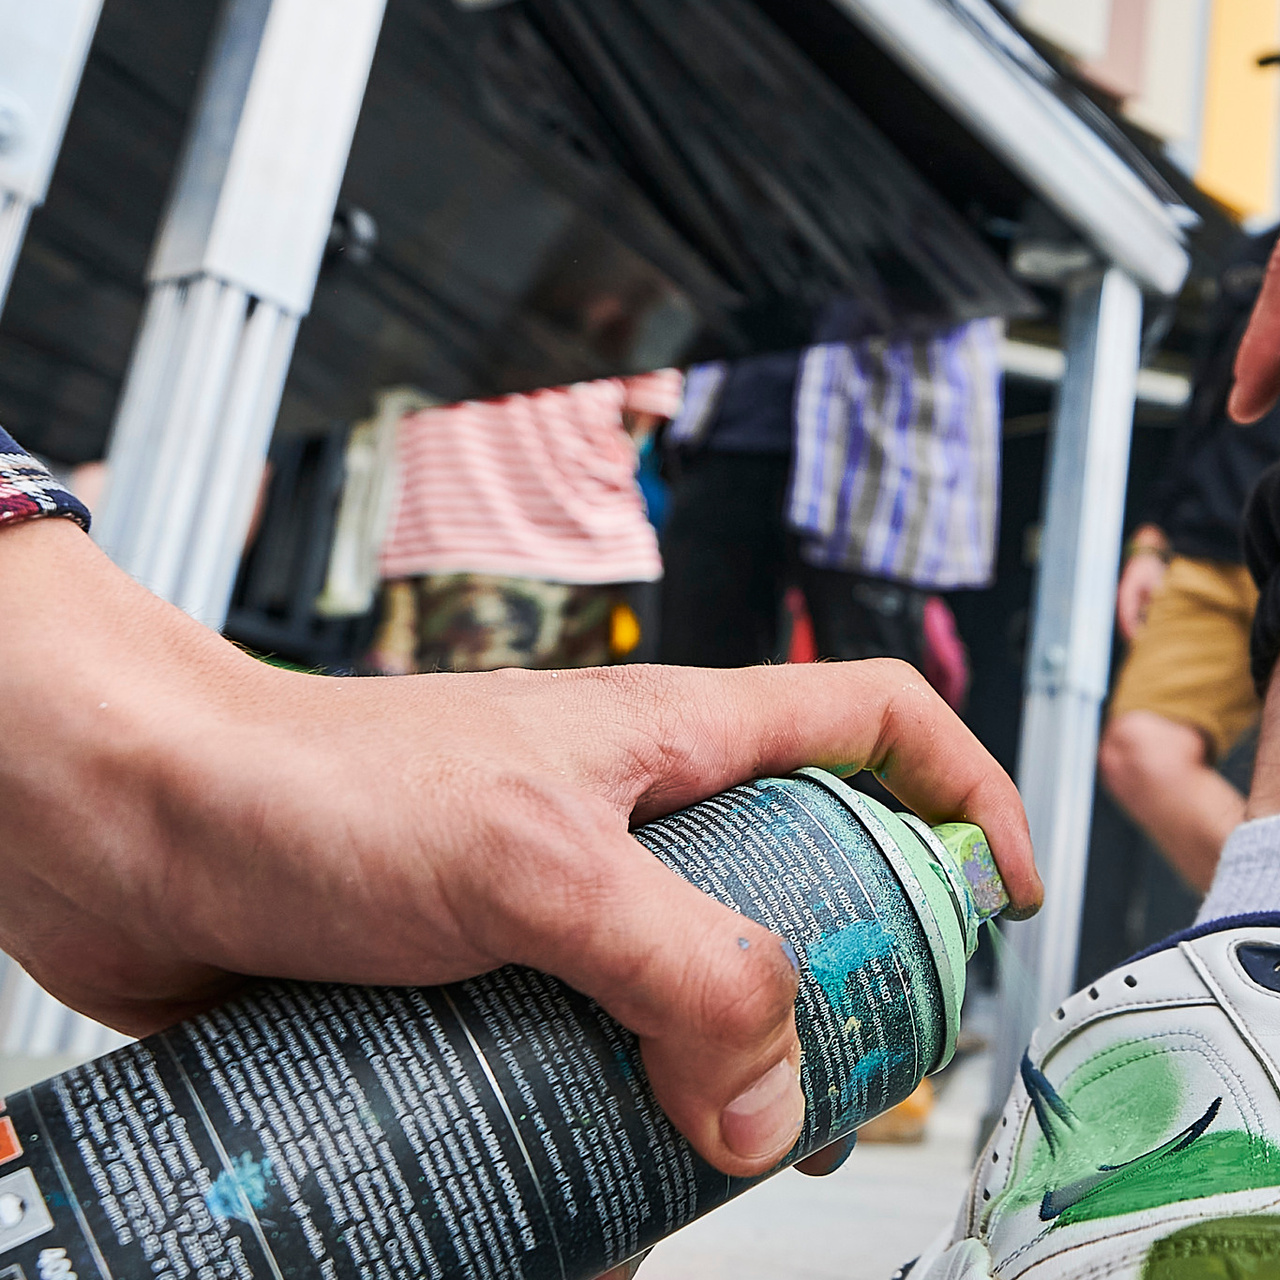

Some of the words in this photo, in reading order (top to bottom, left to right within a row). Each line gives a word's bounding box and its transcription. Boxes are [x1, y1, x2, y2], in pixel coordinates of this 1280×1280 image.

[717, 847, 759, 896] органические
[769, 880, 804, 928] расстояния
[783, 874, 806, 907] баллон
[787, 931, 809, 968] головку
[804, 970, 816, 984] до
[816, 887, 838, 917] краска
[856, 968, 878, 1009] хорошей
[876, 975, 892, 1004] РАБОТ
[474, 996, 490, 1014] and
[486, 990, 522, 1044] equipment.
[522, 995, 542, 1022] open
[484, 1014, 503, 1038] date
[537, 1020, 560, 1052] flame
[496, 1036, 511, 1050] of
[552, 1052, 565, 1065] or
[500, 1049, 540, 1112] production:
[538, 993, 557, 1017] from
[552, 1017, 573, 1048] direct
[565, 1048, 594, 1091] sunlight
[586, 1091, 603, 1112] and
[595, 1113, 624, 1178] temperatures
[555, 997, 587, 1045] pigments,
[581, 1045, 612, 1095] additives,
[605, 1096, 624, 1129] fillers,
[615, 1128, 637, 1172] propane,
[559, 1065, 576, 1085] hot
[503, 988, 523, 1015] cause
[517, 1015, 547, 1061] dizziness
[540, 1061, 559, 1083] and
[569, 1127, 591, 1157] Avoid
[582, 1156, 601, 1196] inhaling
[635, 1095, 646, 1110] by
[531, 1112, 547, 1132] see
[586, 1127, 601, 1144] Do
[640, 1110, 659, 1147] turning
[540, 1131, 564, 1172] bottom
[593, 1144, 606, 1162] not
[652, 1145, 664, 1163] the
[556, 1170, 570, 1183] of
[657, 1163, 667, 1180] can
[560, 1183, 574, 1200] the
